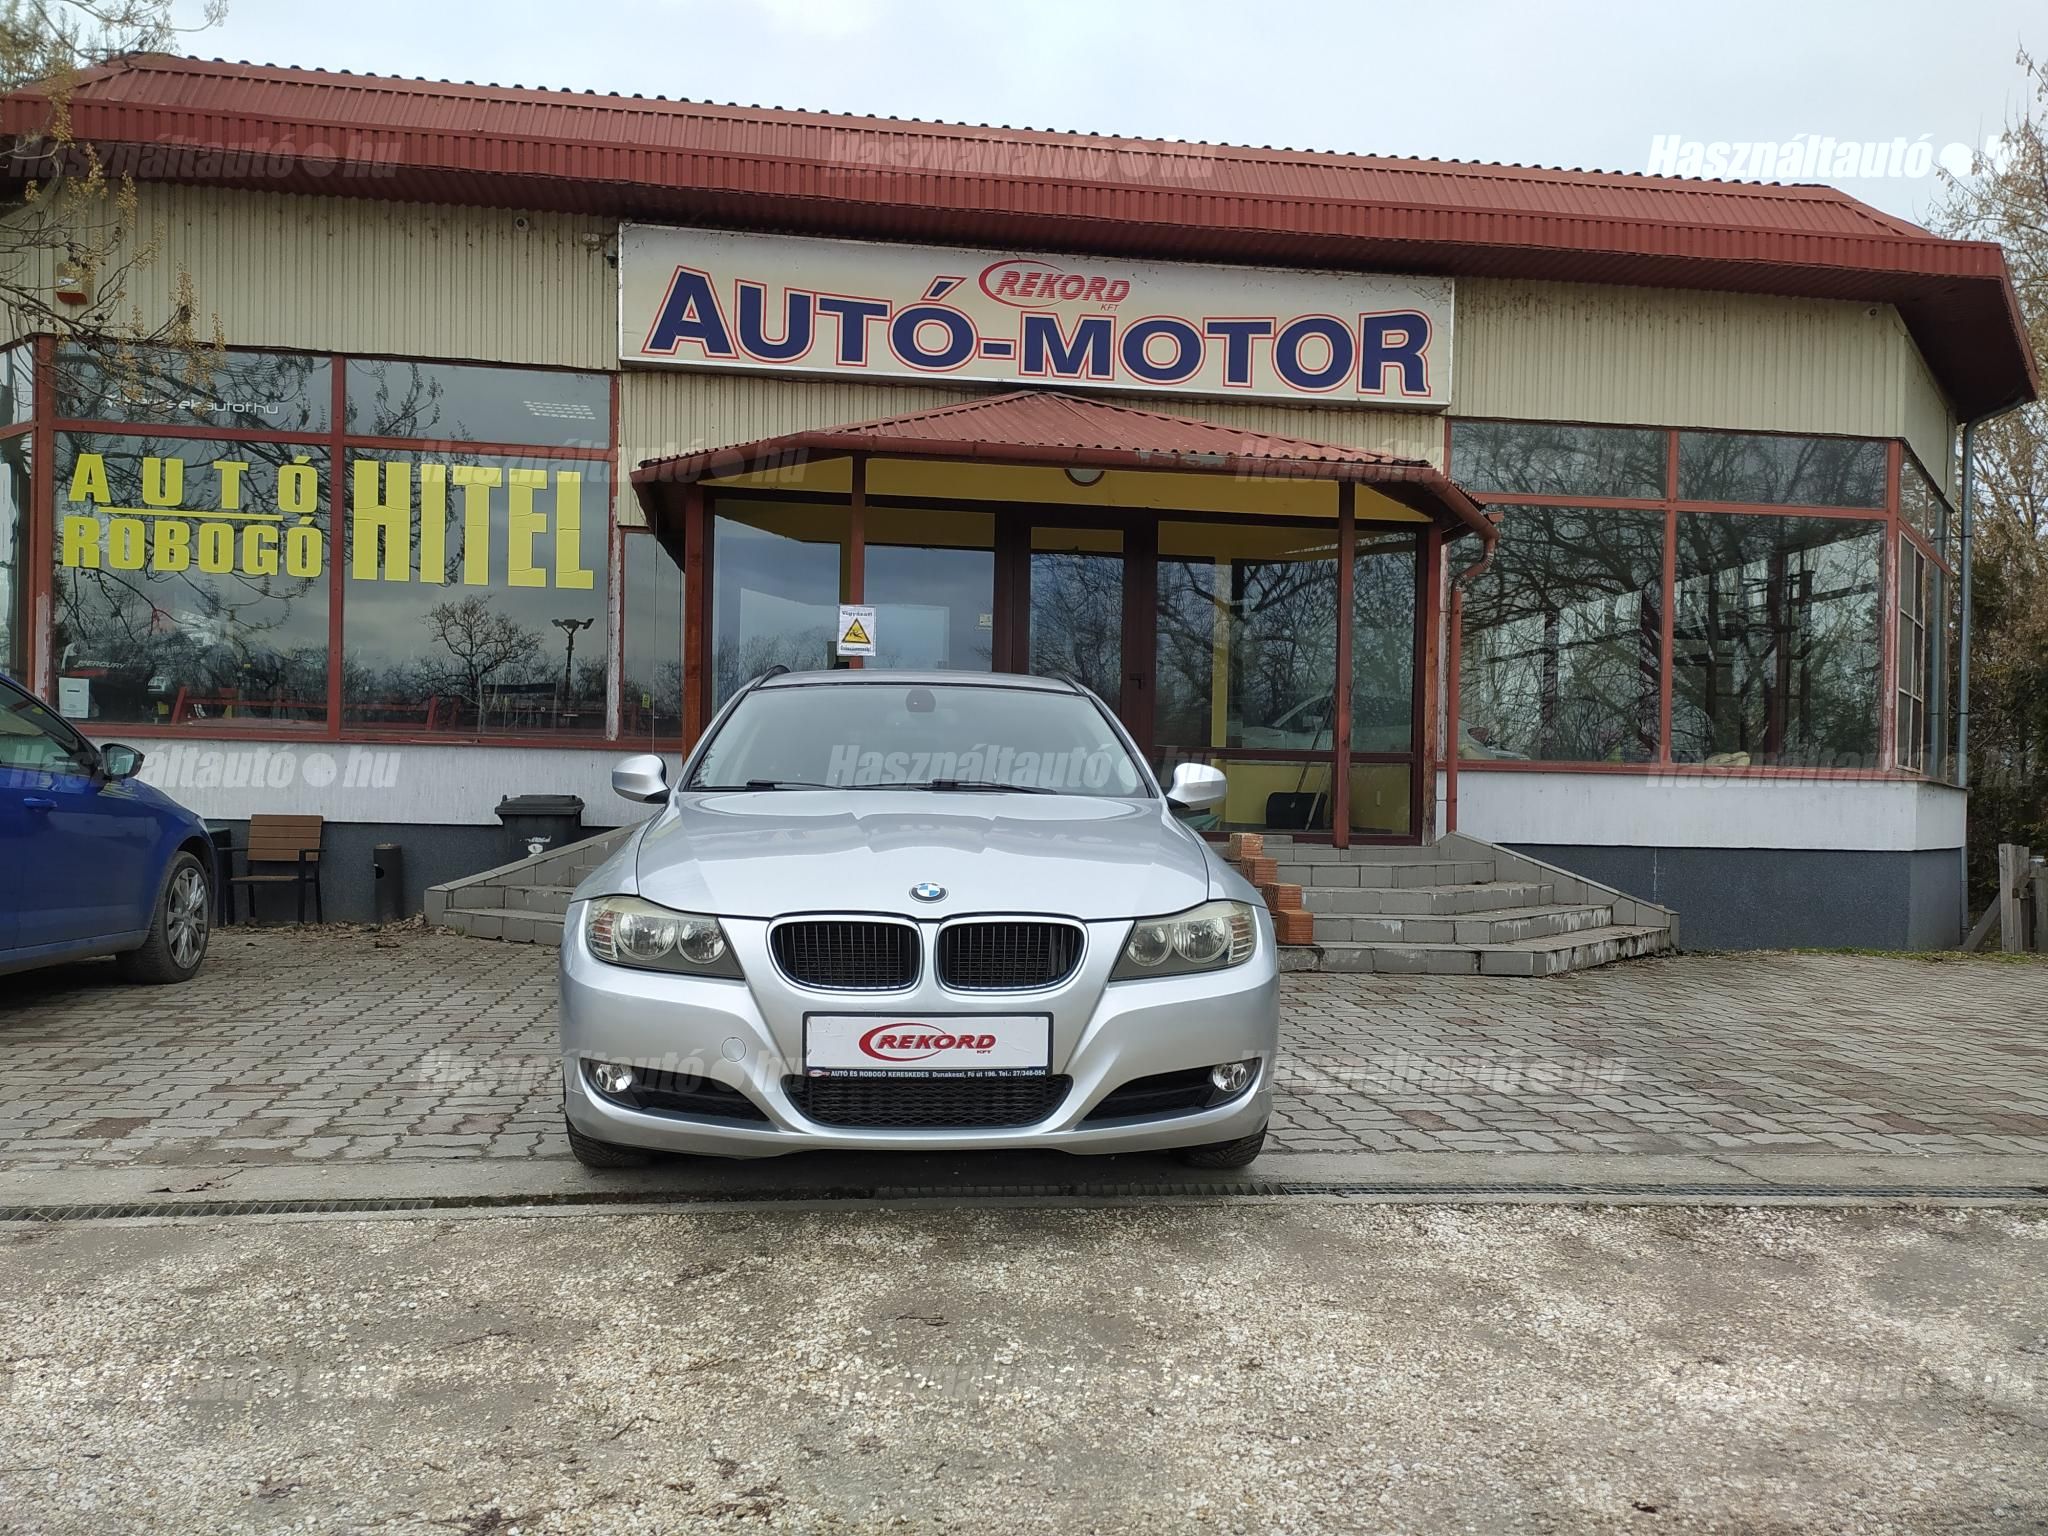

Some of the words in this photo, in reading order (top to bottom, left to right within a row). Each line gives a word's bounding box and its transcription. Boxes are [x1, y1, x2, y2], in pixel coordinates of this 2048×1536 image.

[995, 271, 1131, 303] REKORD
[1100, 304, 1119, 312] KFT
[641, 264, 1432, 397] AUTÓ-MOTOR
[68, 453, 318, 513] AUTÓ
[63, 515, 322, 578] ROBOGÓ
[352, 460, 594, 590] HITEL
[876, 1034, 997, 1050] REKORD
[830, 1069, 848, 1077] AUTÓ
